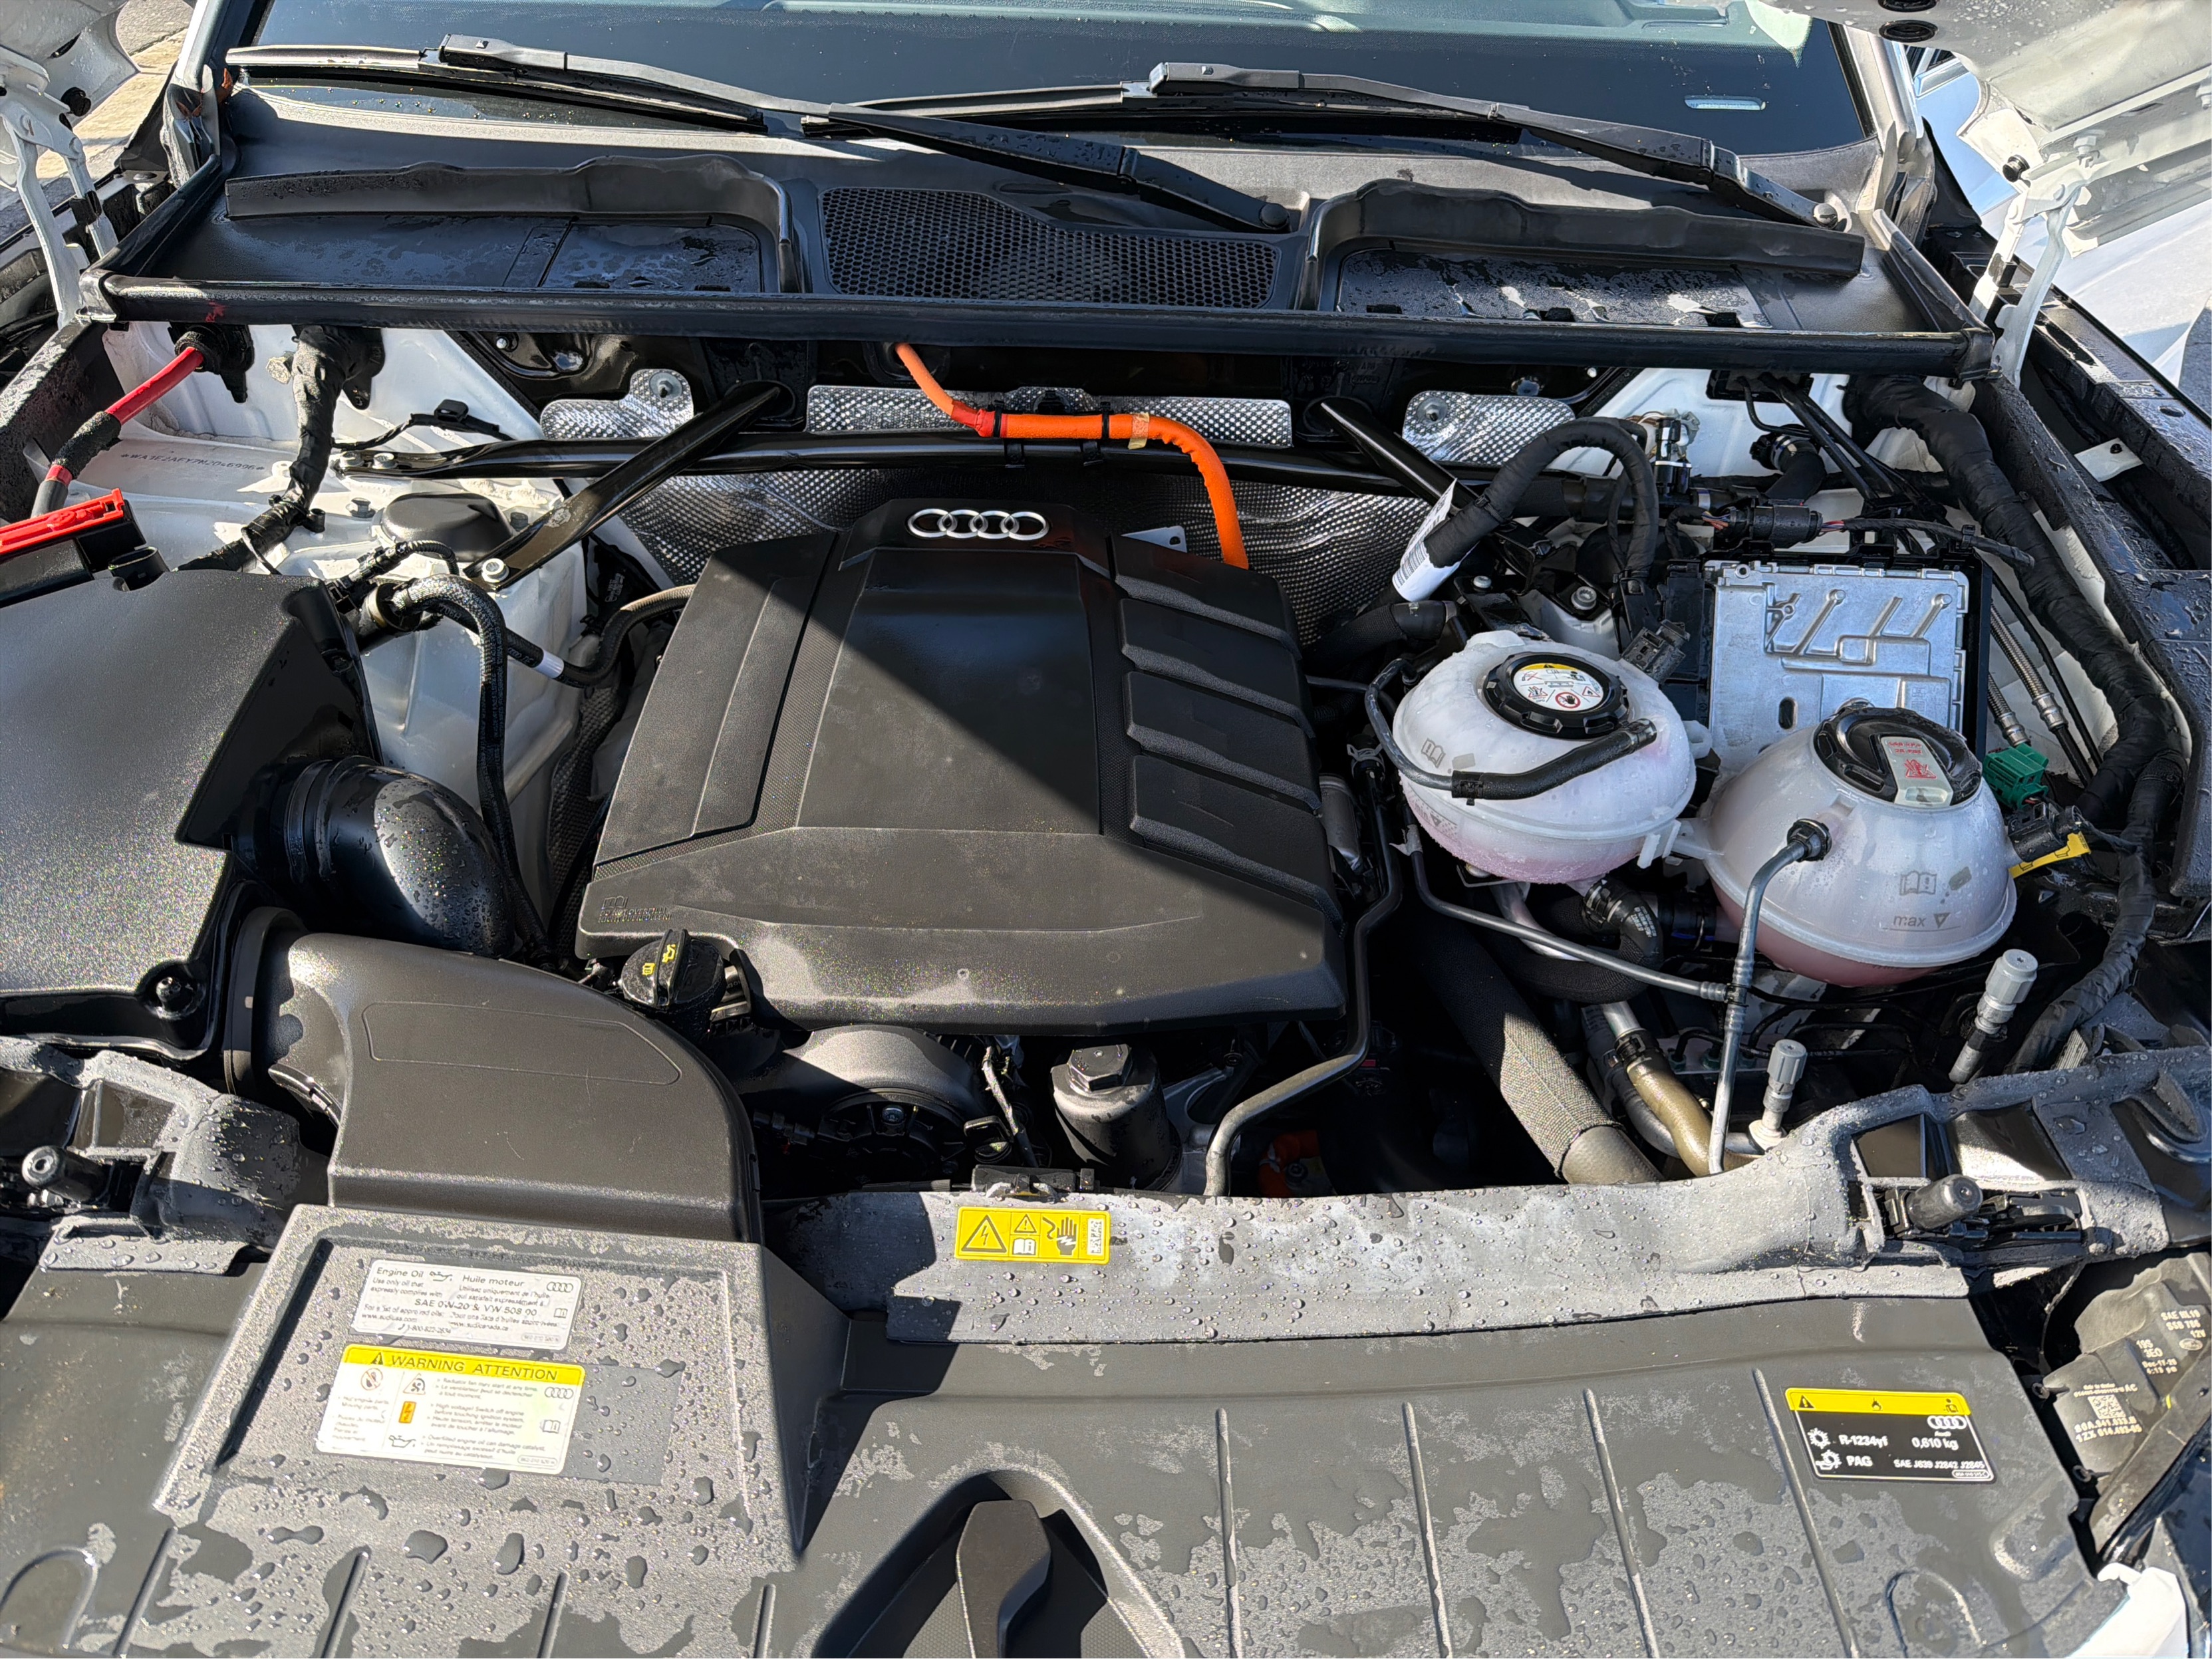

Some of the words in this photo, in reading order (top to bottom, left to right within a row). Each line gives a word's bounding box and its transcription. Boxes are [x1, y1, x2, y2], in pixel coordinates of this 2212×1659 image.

[1893, 916, 1927, 927] max
[376, 1267, 408, 1277] Engine
[462, 1275, 485, 1284] Huile
[489, 1278, 525, 1287] moteur
[2161, 1311, 2179, 1321] SAE
[2190, 1329, 2206, 1338] 12V
[391, 1355, 465, 1372] WARNING
[472, 1364, 557, 1380] ATTENTION
[1838, 1434, 1888, 1449] R-1234yf
[1911, 1436, 1942, 1449] 0,610
[1943, 1438, 1959, 1450] kg
[1846, 1455, 1873, 1467] PAG
[1893, 1459, 1913, 1468] SAE
